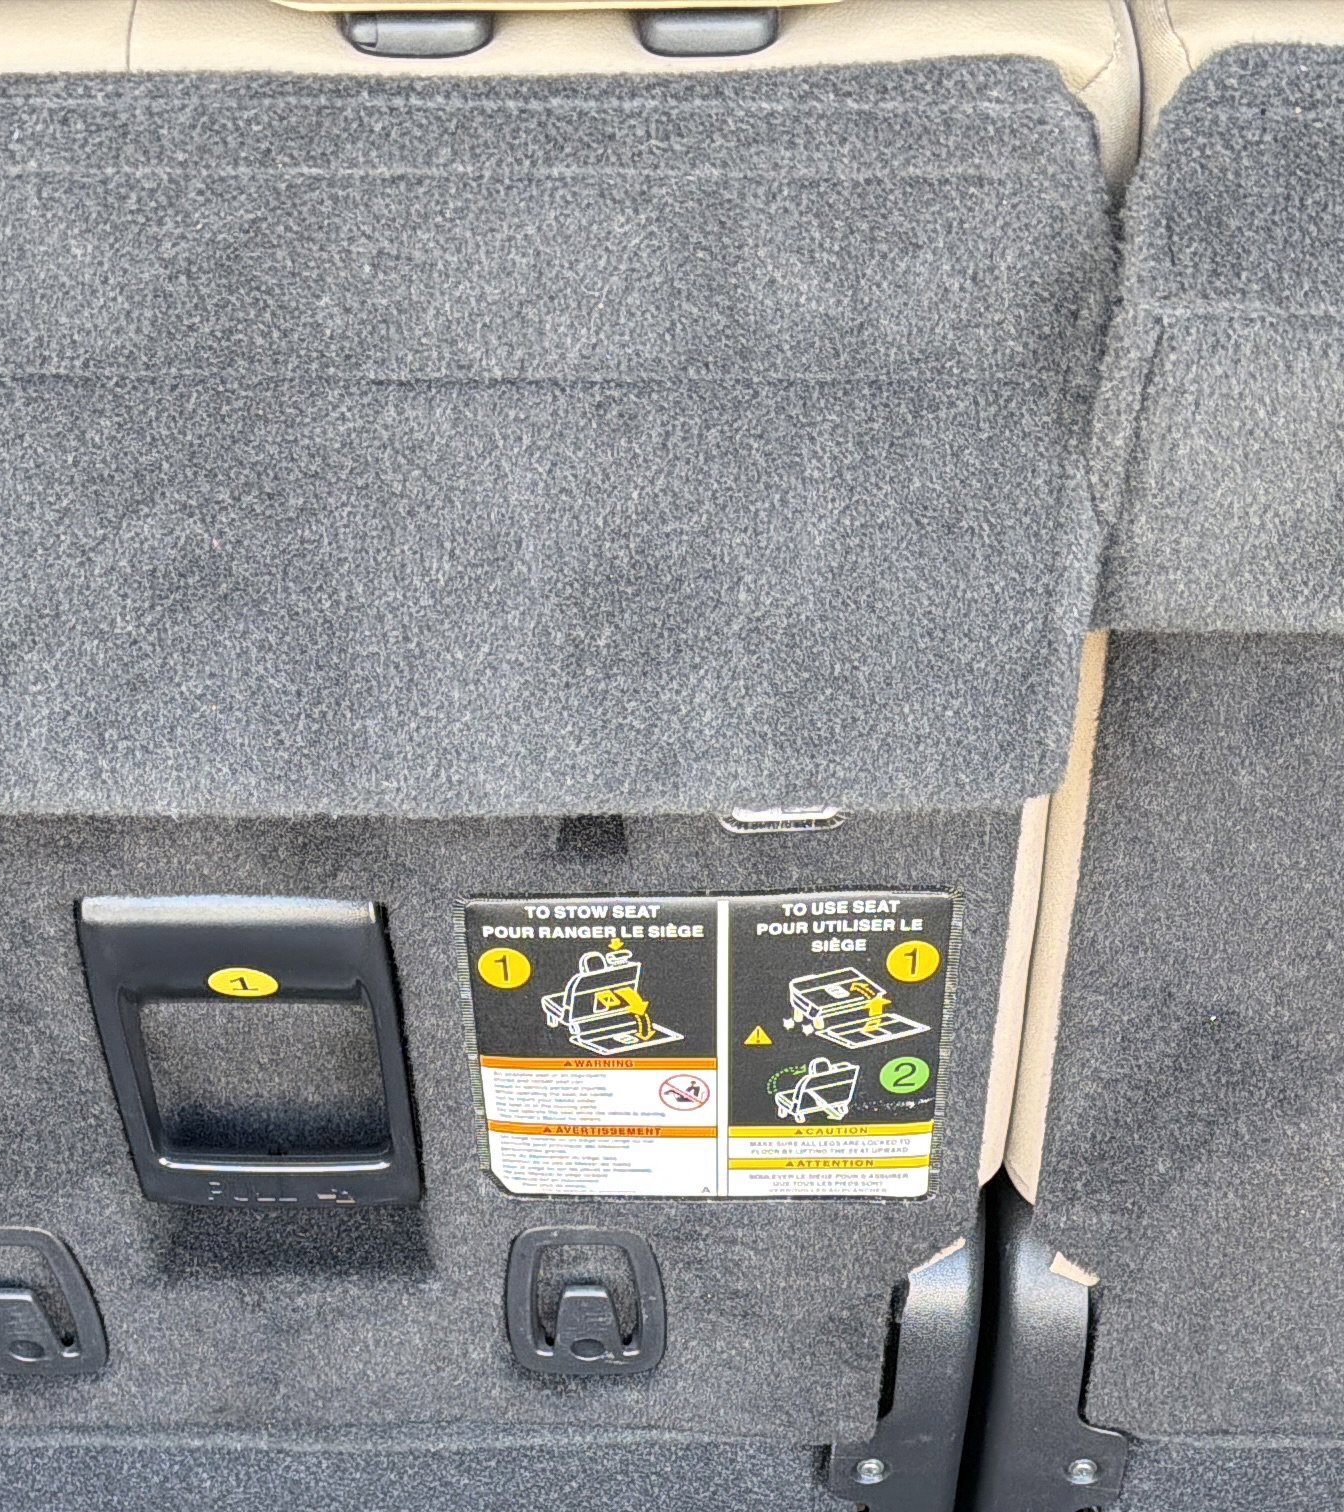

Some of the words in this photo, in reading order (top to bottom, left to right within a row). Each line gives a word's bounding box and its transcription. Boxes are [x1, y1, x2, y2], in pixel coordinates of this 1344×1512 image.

[524, 905, 550, 919] TO
[555, 905, 608, 919] STOW
[612, 905, 660, 919] SEAT
[782, 903, 807, 916] TO
[811, 901, 848, 915] USE
[852, 900, 901, 914] SEAT
[482, 926, 534, 939] POUR
[538, 926, 616, 938] RANGER
[621, 926, 644, 938] LE
[648, 923, 704, 938] SIÈGE
[756, 922, 808, 936] POUR
[812, 919, 896, 933] UTILISER
[900, 918, 923, 931] LE
[811, 937, 867, 952] SIÈGE
[493, 954, 510, 983] 1
[904, 947, 919, 975] 1
[573, 1059, 634, 1068] WARNING
[892, 1062, 916, 1087] 2
[555, 1126, 662, 1136] AVERTISSEMENT
[806, 1127, 868, 1135] CAUTION
[797, 1159, 874, 1168] ATTENTION
